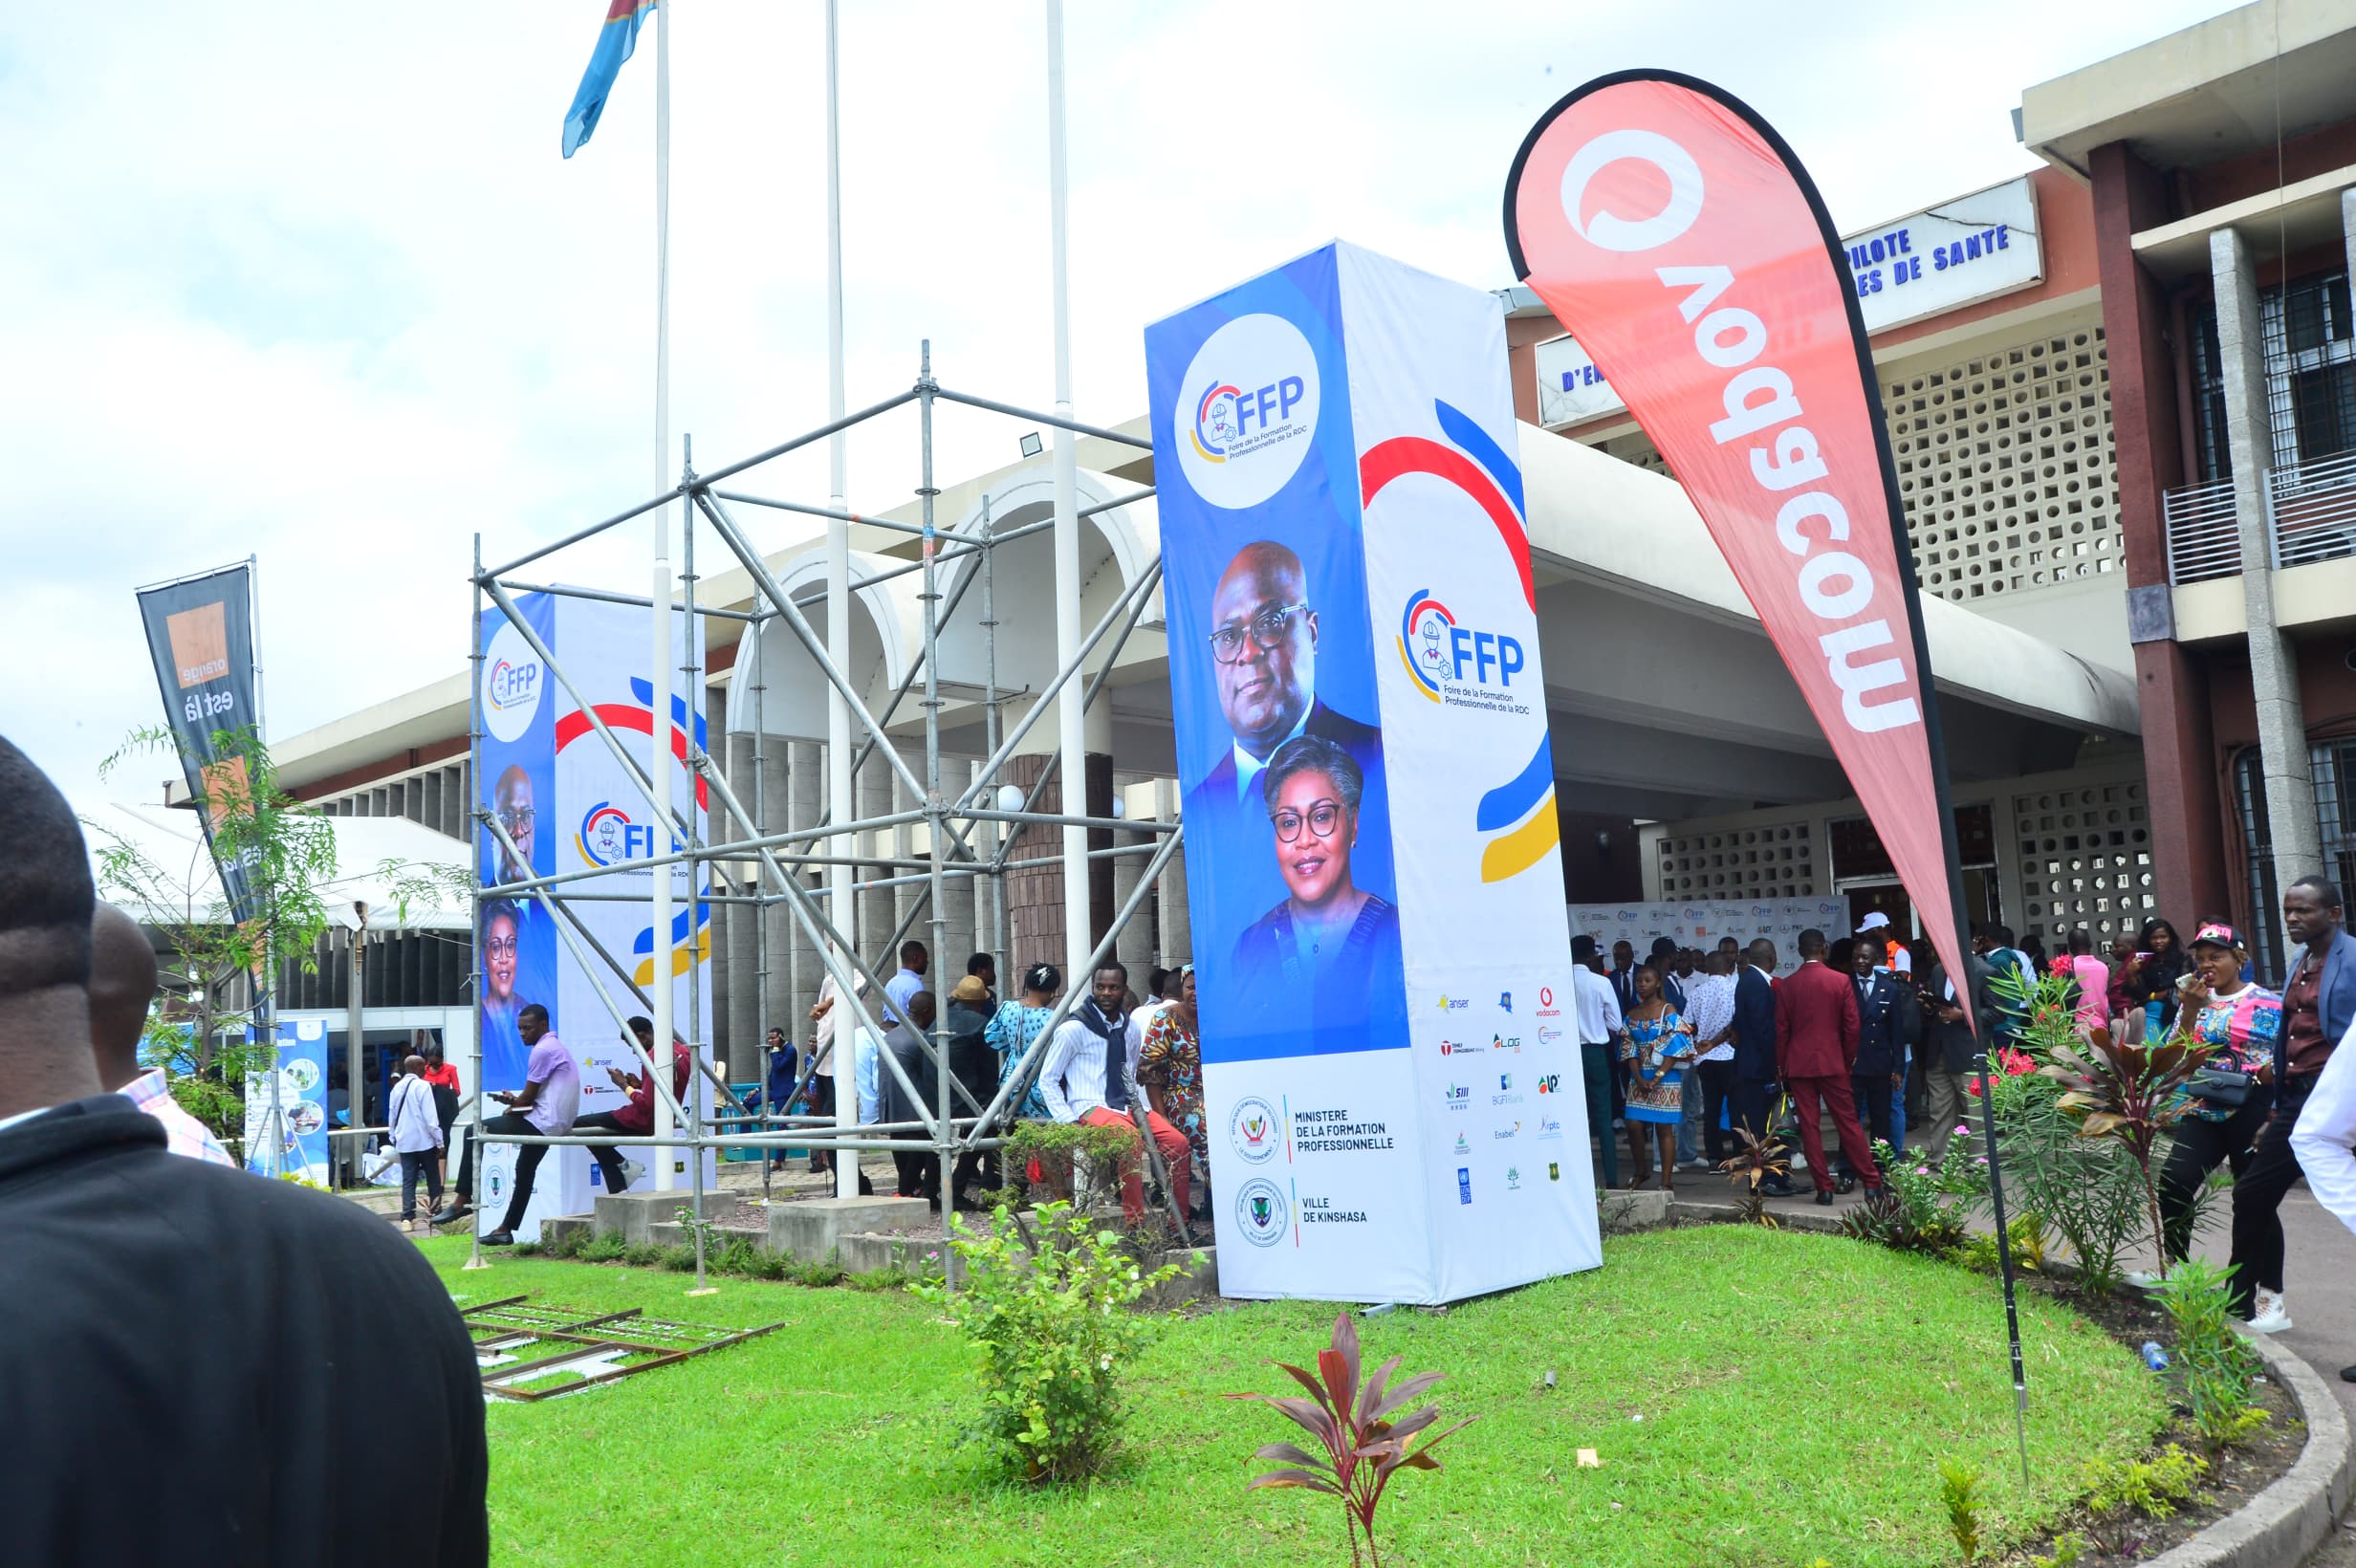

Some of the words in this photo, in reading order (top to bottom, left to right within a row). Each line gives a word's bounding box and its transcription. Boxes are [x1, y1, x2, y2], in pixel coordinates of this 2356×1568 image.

[1893, 255, 1922, 285] DE
[1933, 224, 2010, 271] SANTE
[1235, 375, 1304, 437] FFP
[1228, 441, 1244, 452] Foire
[1245, 438, 1254, 446] de
[1260, 424, 1293, 441] Formation
[1229, 438, 1276, 459] Professionnelle
[1276, 433, 1286, 443] de
[1293, 425, 1307, 437] RDC
[1450, 626, 1524, 687] FFP
[508, 664, 536, 696] FFP
[1444, 685, 1462, 695] Foire
[1462, 687, 1472, 697] de
[1472, 687, 1479, 698] la
[1479, 689, 1514, 703] Formation
[1445, 695, 1497, 711] Professionnelle
[1497, 703, 1507, 712] de
[1507, 704, 1515, 713] la
[1515, 705, 1530, 715] RDC
[1449, 999, 1469, 1009] anser
[1536, 1009, 1561, 1017] vodacom
[1295, 1109, 1348, 1123] MINISTERE
[1296, 1125, 1310, 1138] DE
[1311, 1125, 1325, 1137] LA
[1326, 1122, 1385, 1137] FORMATION
[1298, 1138, 1394, 1152] PROFESSIONNELLE
[1302, 1197, 1330, 1209] VILLE
[1303, 1211, 1316, 1223] DE
[1318, 1210, 1367, 1223] KINSHASA
